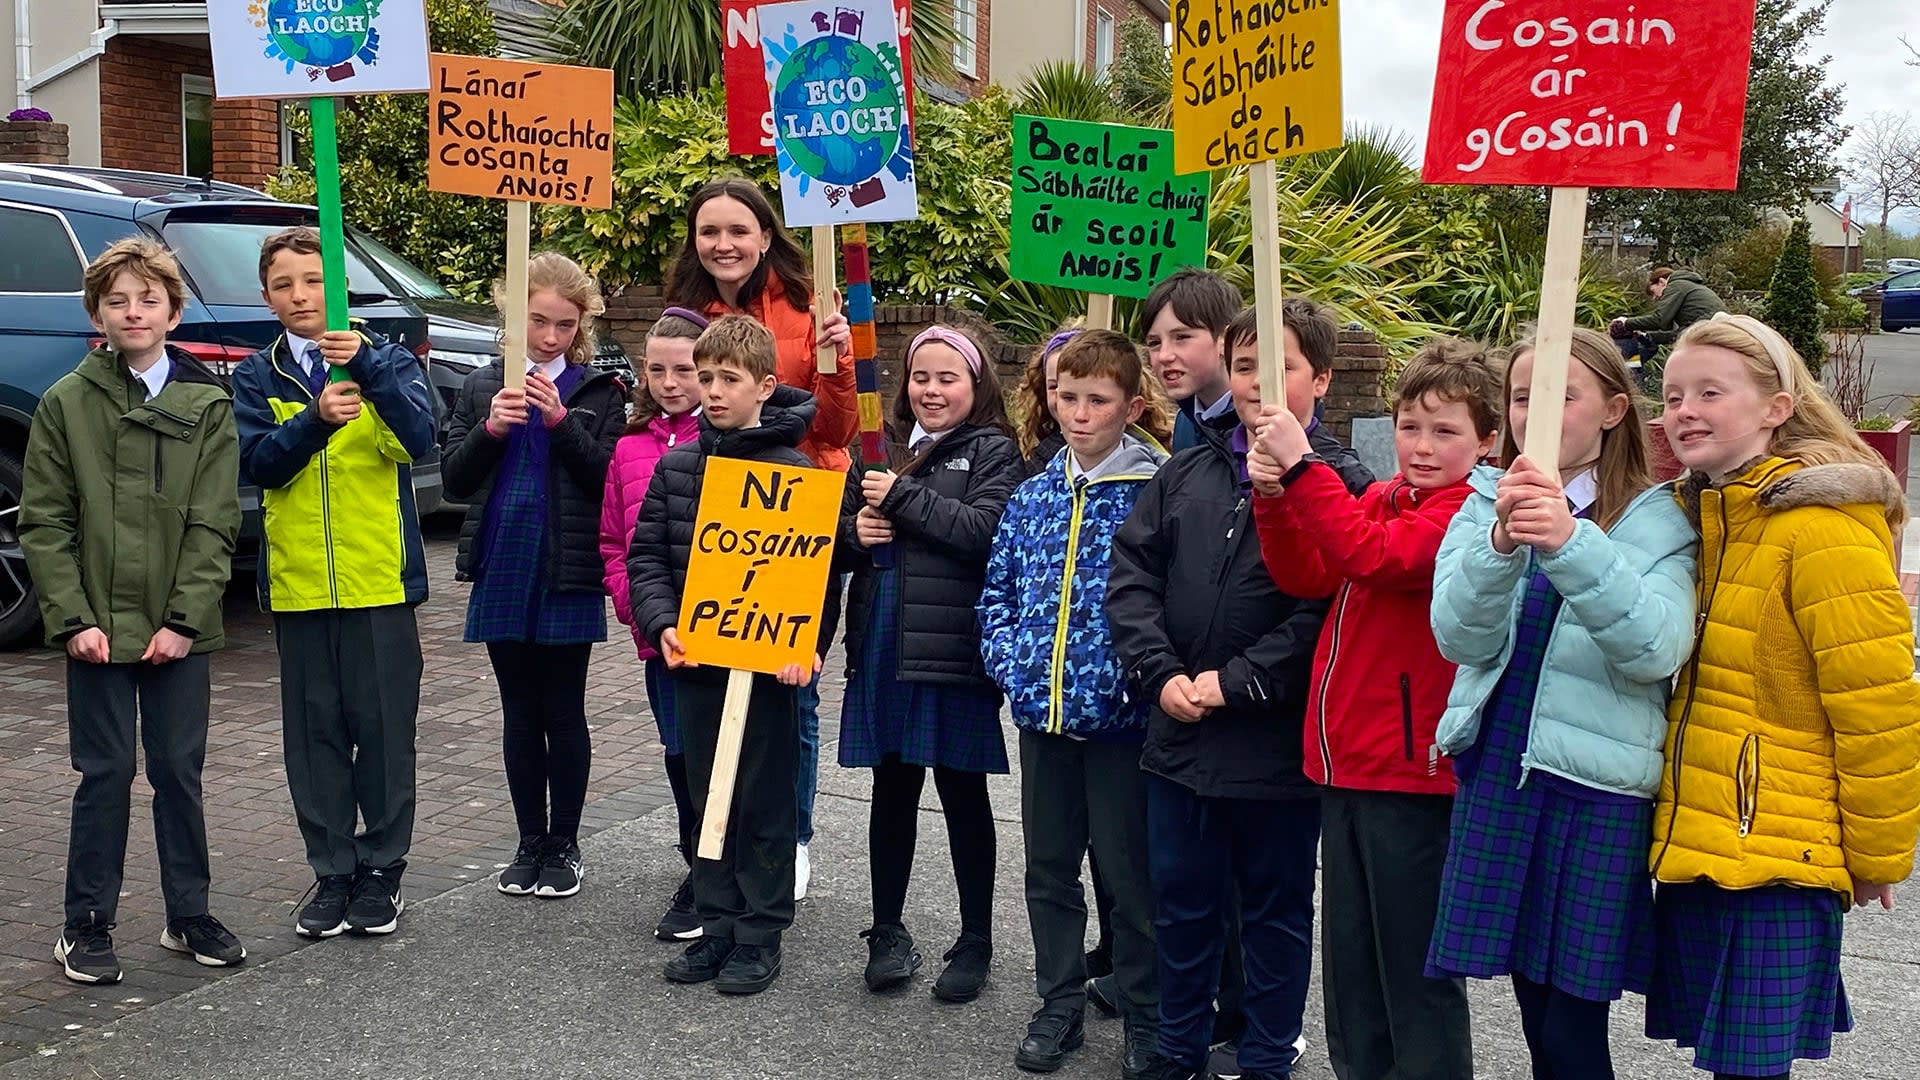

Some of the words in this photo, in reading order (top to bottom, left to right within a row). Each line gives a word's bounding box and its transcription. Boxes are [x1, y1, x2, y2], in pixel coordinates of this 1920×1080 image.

[276, 15, 366, 35] LAOCH
[295, 0, 343, 13] ECO
[1464, 0, 1676, 50] Cosain
[440, 67, 542, 99] Lánaí
[803, 76, 867, 106] ECO
[1183, 33, 1315, 107] Sábháilte
[1530, 54, 1587, 98] ár
[437, 100, 611, 151] Rothaíochta
[783, 106, 898, 139] LAOCH
[1231, 92, 1262, 129] do
[1029, 121, 1159, 172] Bealaí
[1456, 106, 1649, 172] gCosáin
[1017, 166, 1139, 204] Sábháilte
[1148, 180, 1207, 222] chuig
[1032, 203, 1064, 234] ár
[740, 470, 804, 512] Ní
